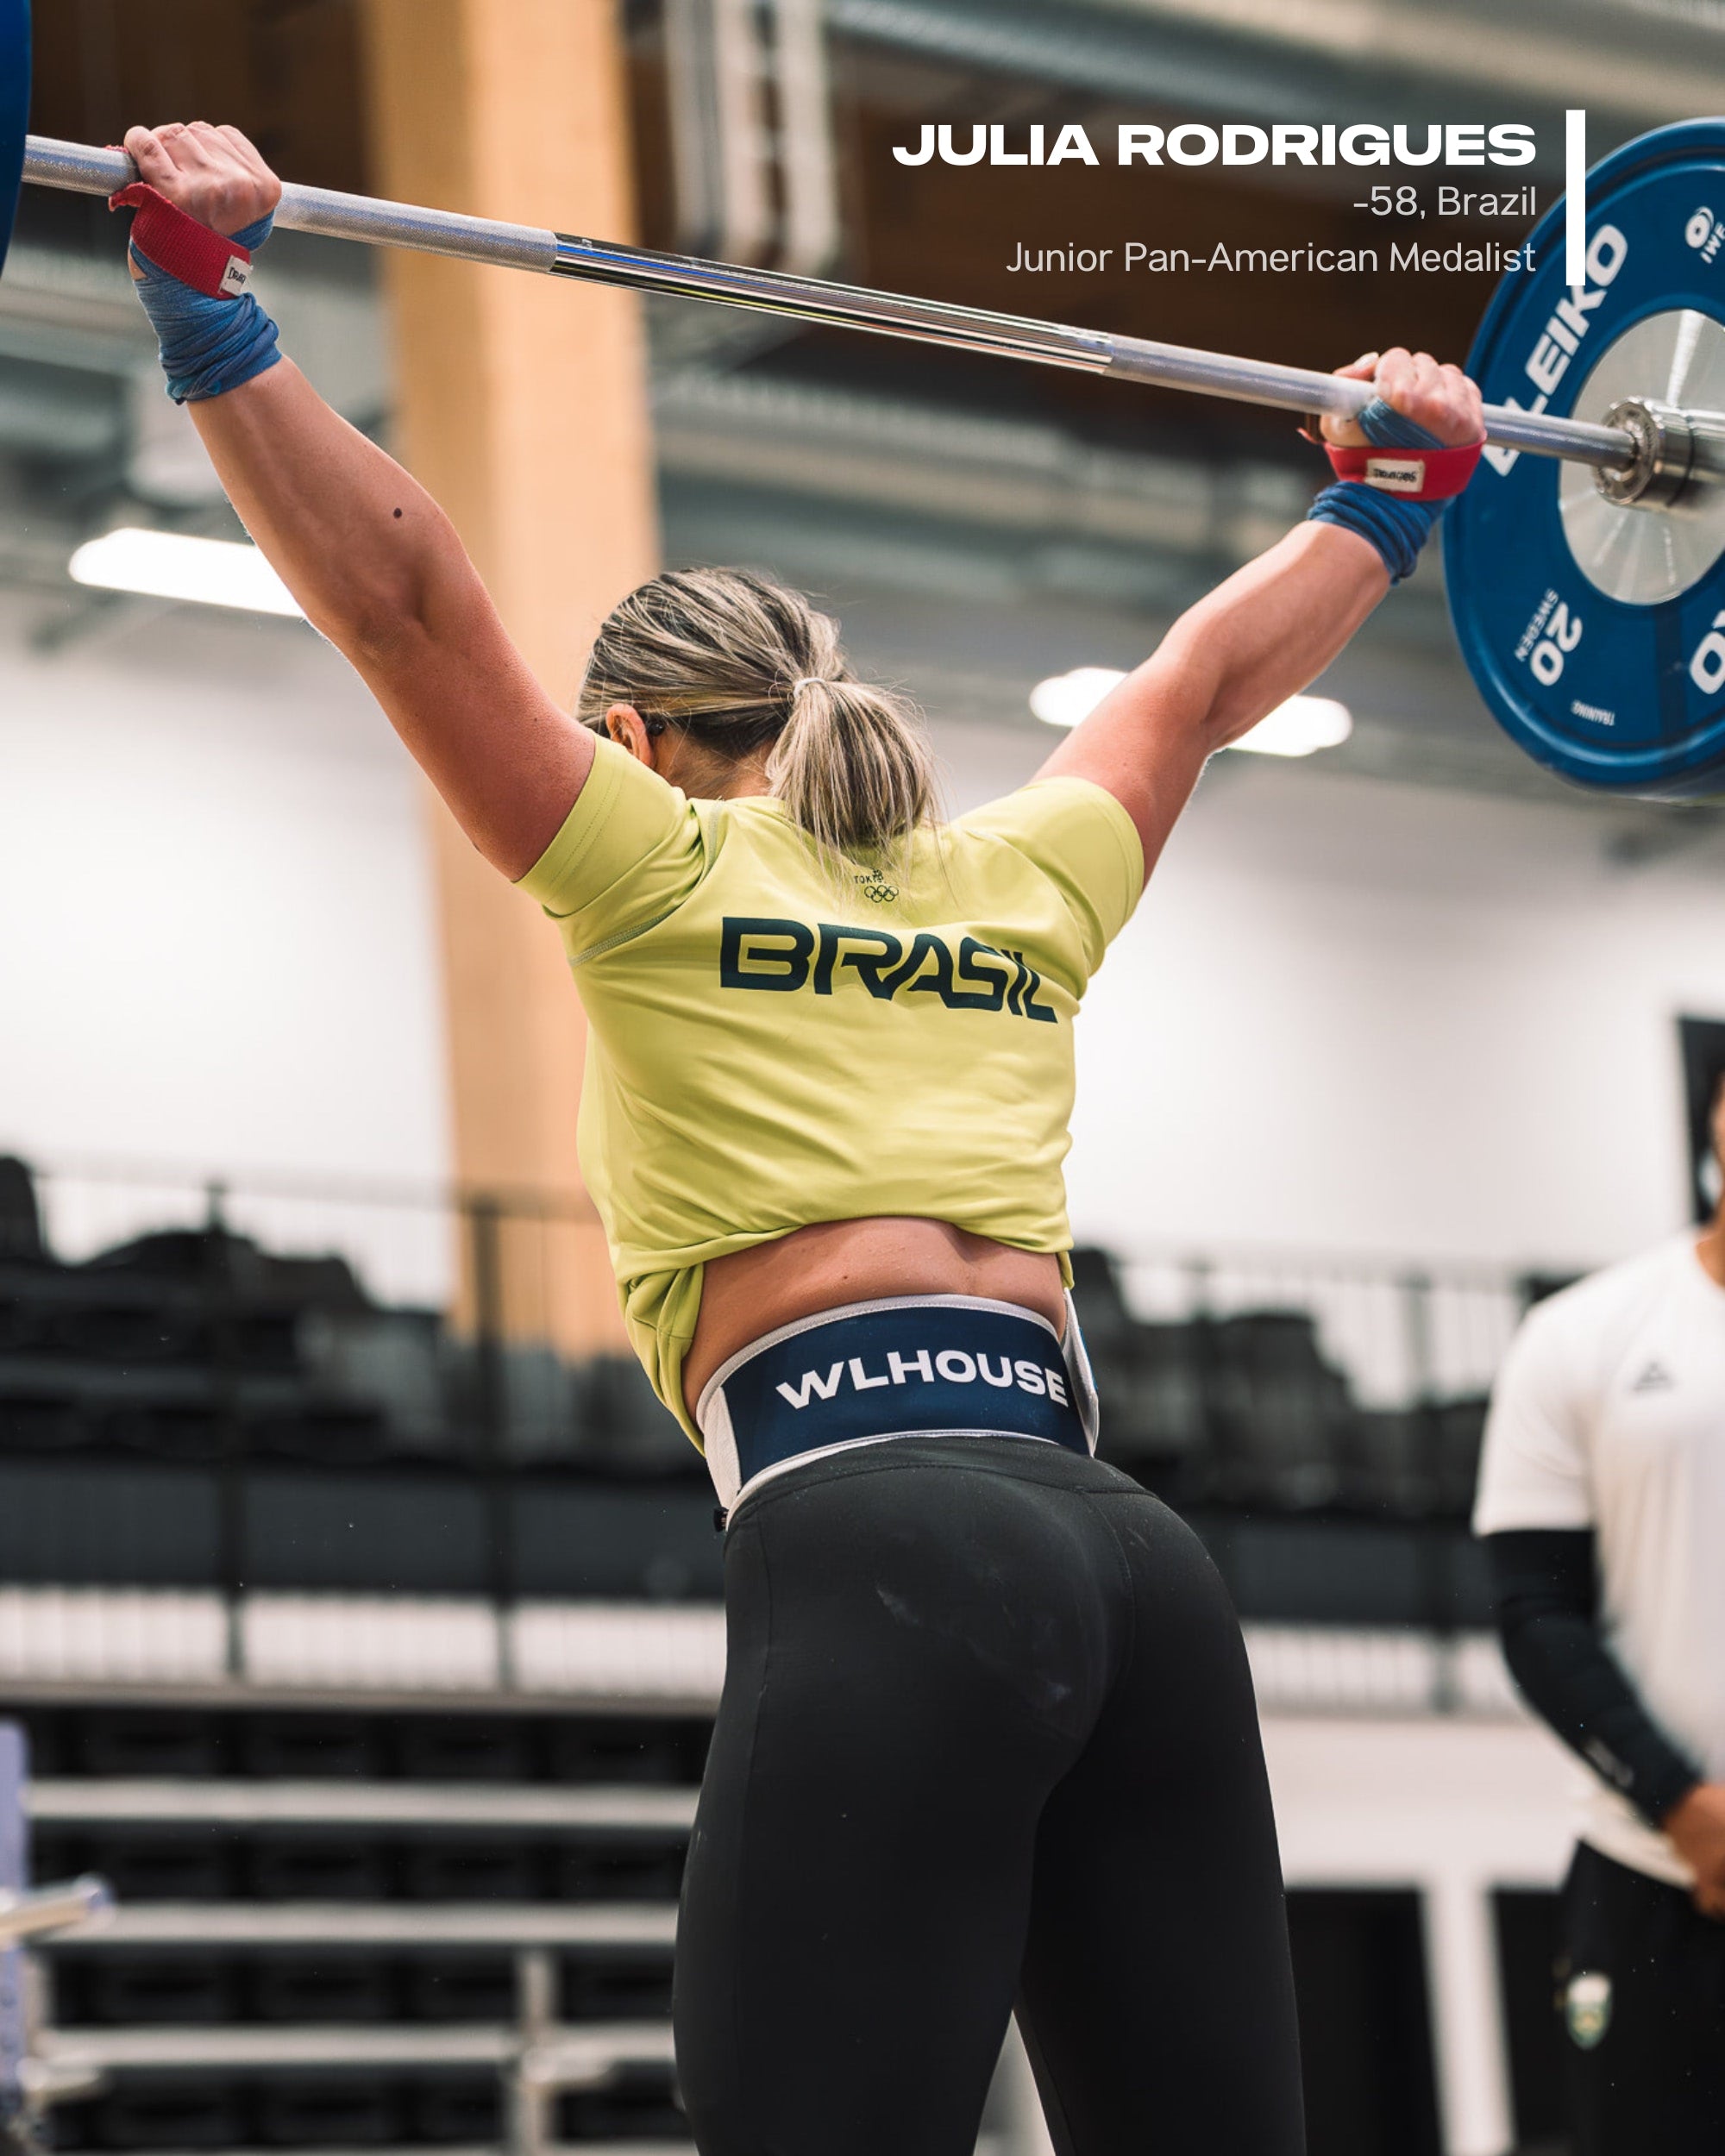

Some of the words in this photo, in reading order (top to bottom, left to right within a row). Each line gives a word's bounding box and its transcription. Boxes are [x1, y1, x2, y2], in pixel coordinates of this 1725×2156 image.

[1515, 588, 1559, 662] SWEDEN
[1530, 602, 1583, 686] 20
[1571, 700, 1615, 726] TRAINING
[720, 917, 1058, 1023] BRASIL
[775, 1350, 1069, 1410] WLHOUSE
